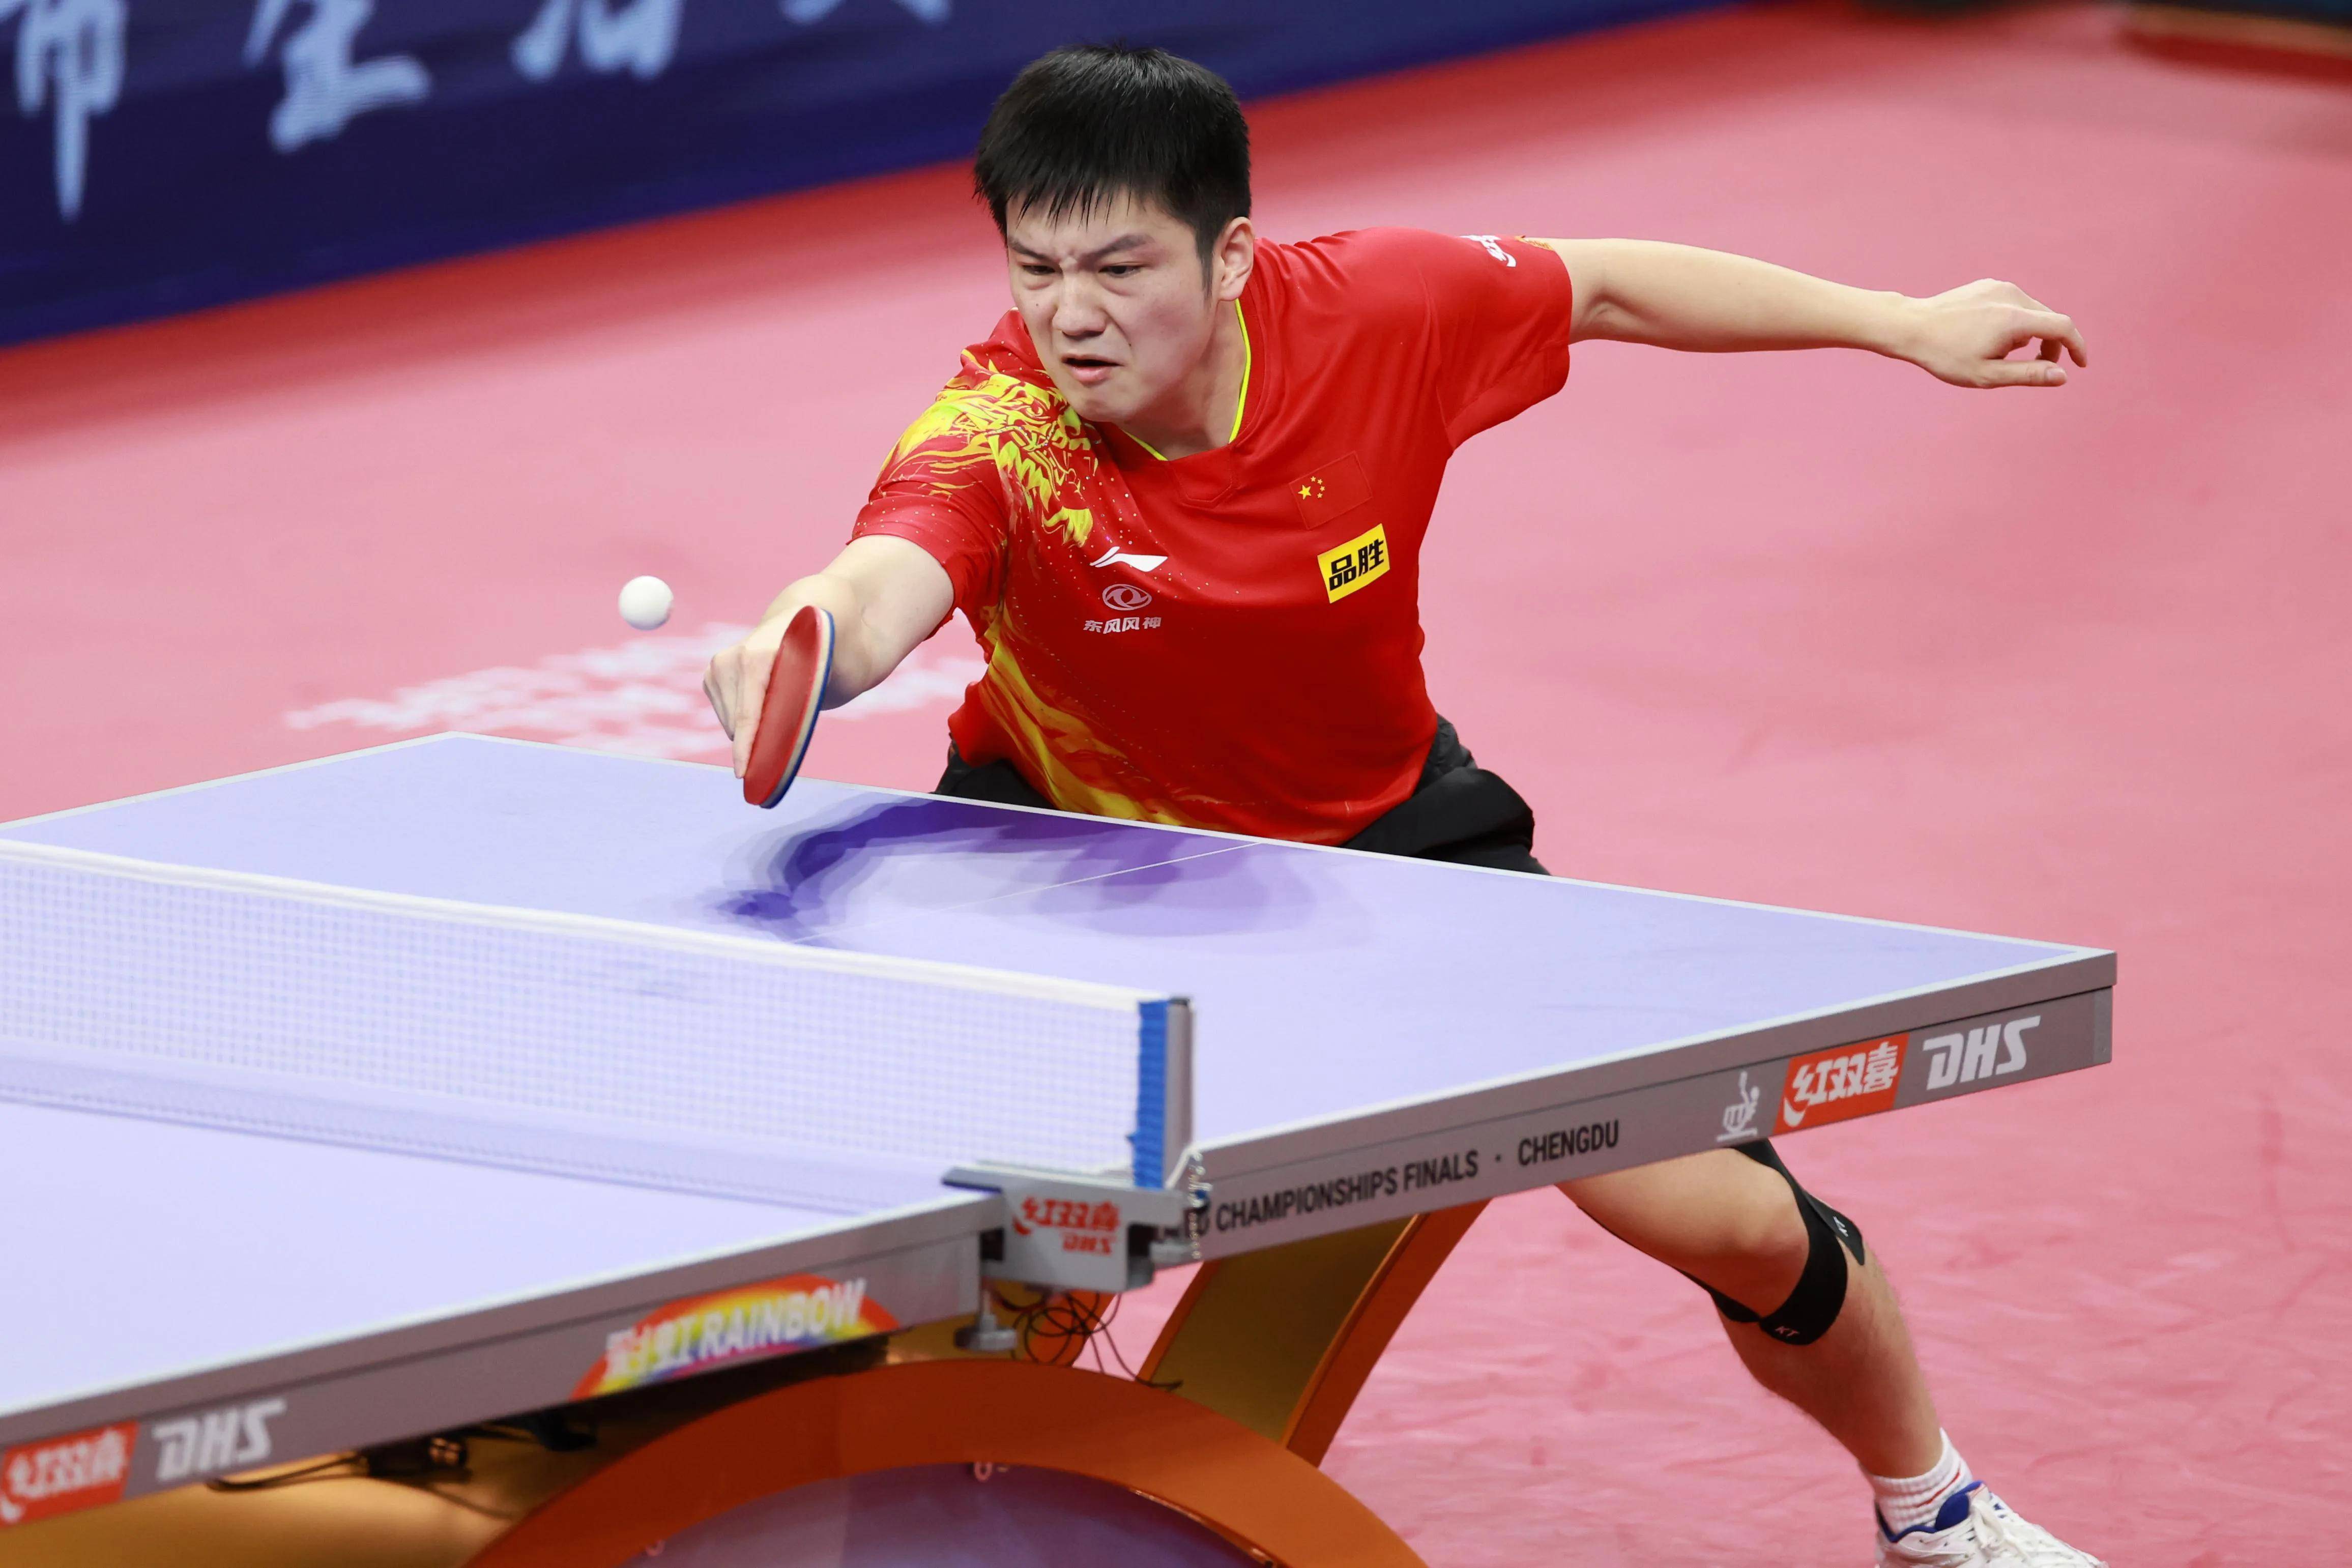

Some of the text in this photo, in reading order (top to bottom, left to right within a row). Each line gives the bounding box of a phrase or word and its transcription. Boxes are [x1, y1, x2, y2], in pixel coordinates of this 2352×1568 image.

[1329, 538, 1384, 592] 品胜
[1083, 616, 1162, 634] 东风风神
[1783, 1041, 1899, 1127] 红双喜
[1923, 1015, 2041, 1091] DHS
[1216, 1167, 1398, 1232] CHAMPIONSHIPS
[1403, 1149, 1479, 1191] FINALS
[1518, 1119, 1619, 1167] CHENGDU
[698, 1277, 867, 1361] RAINBOW
[152, 1397, 286, 1482] DHS
